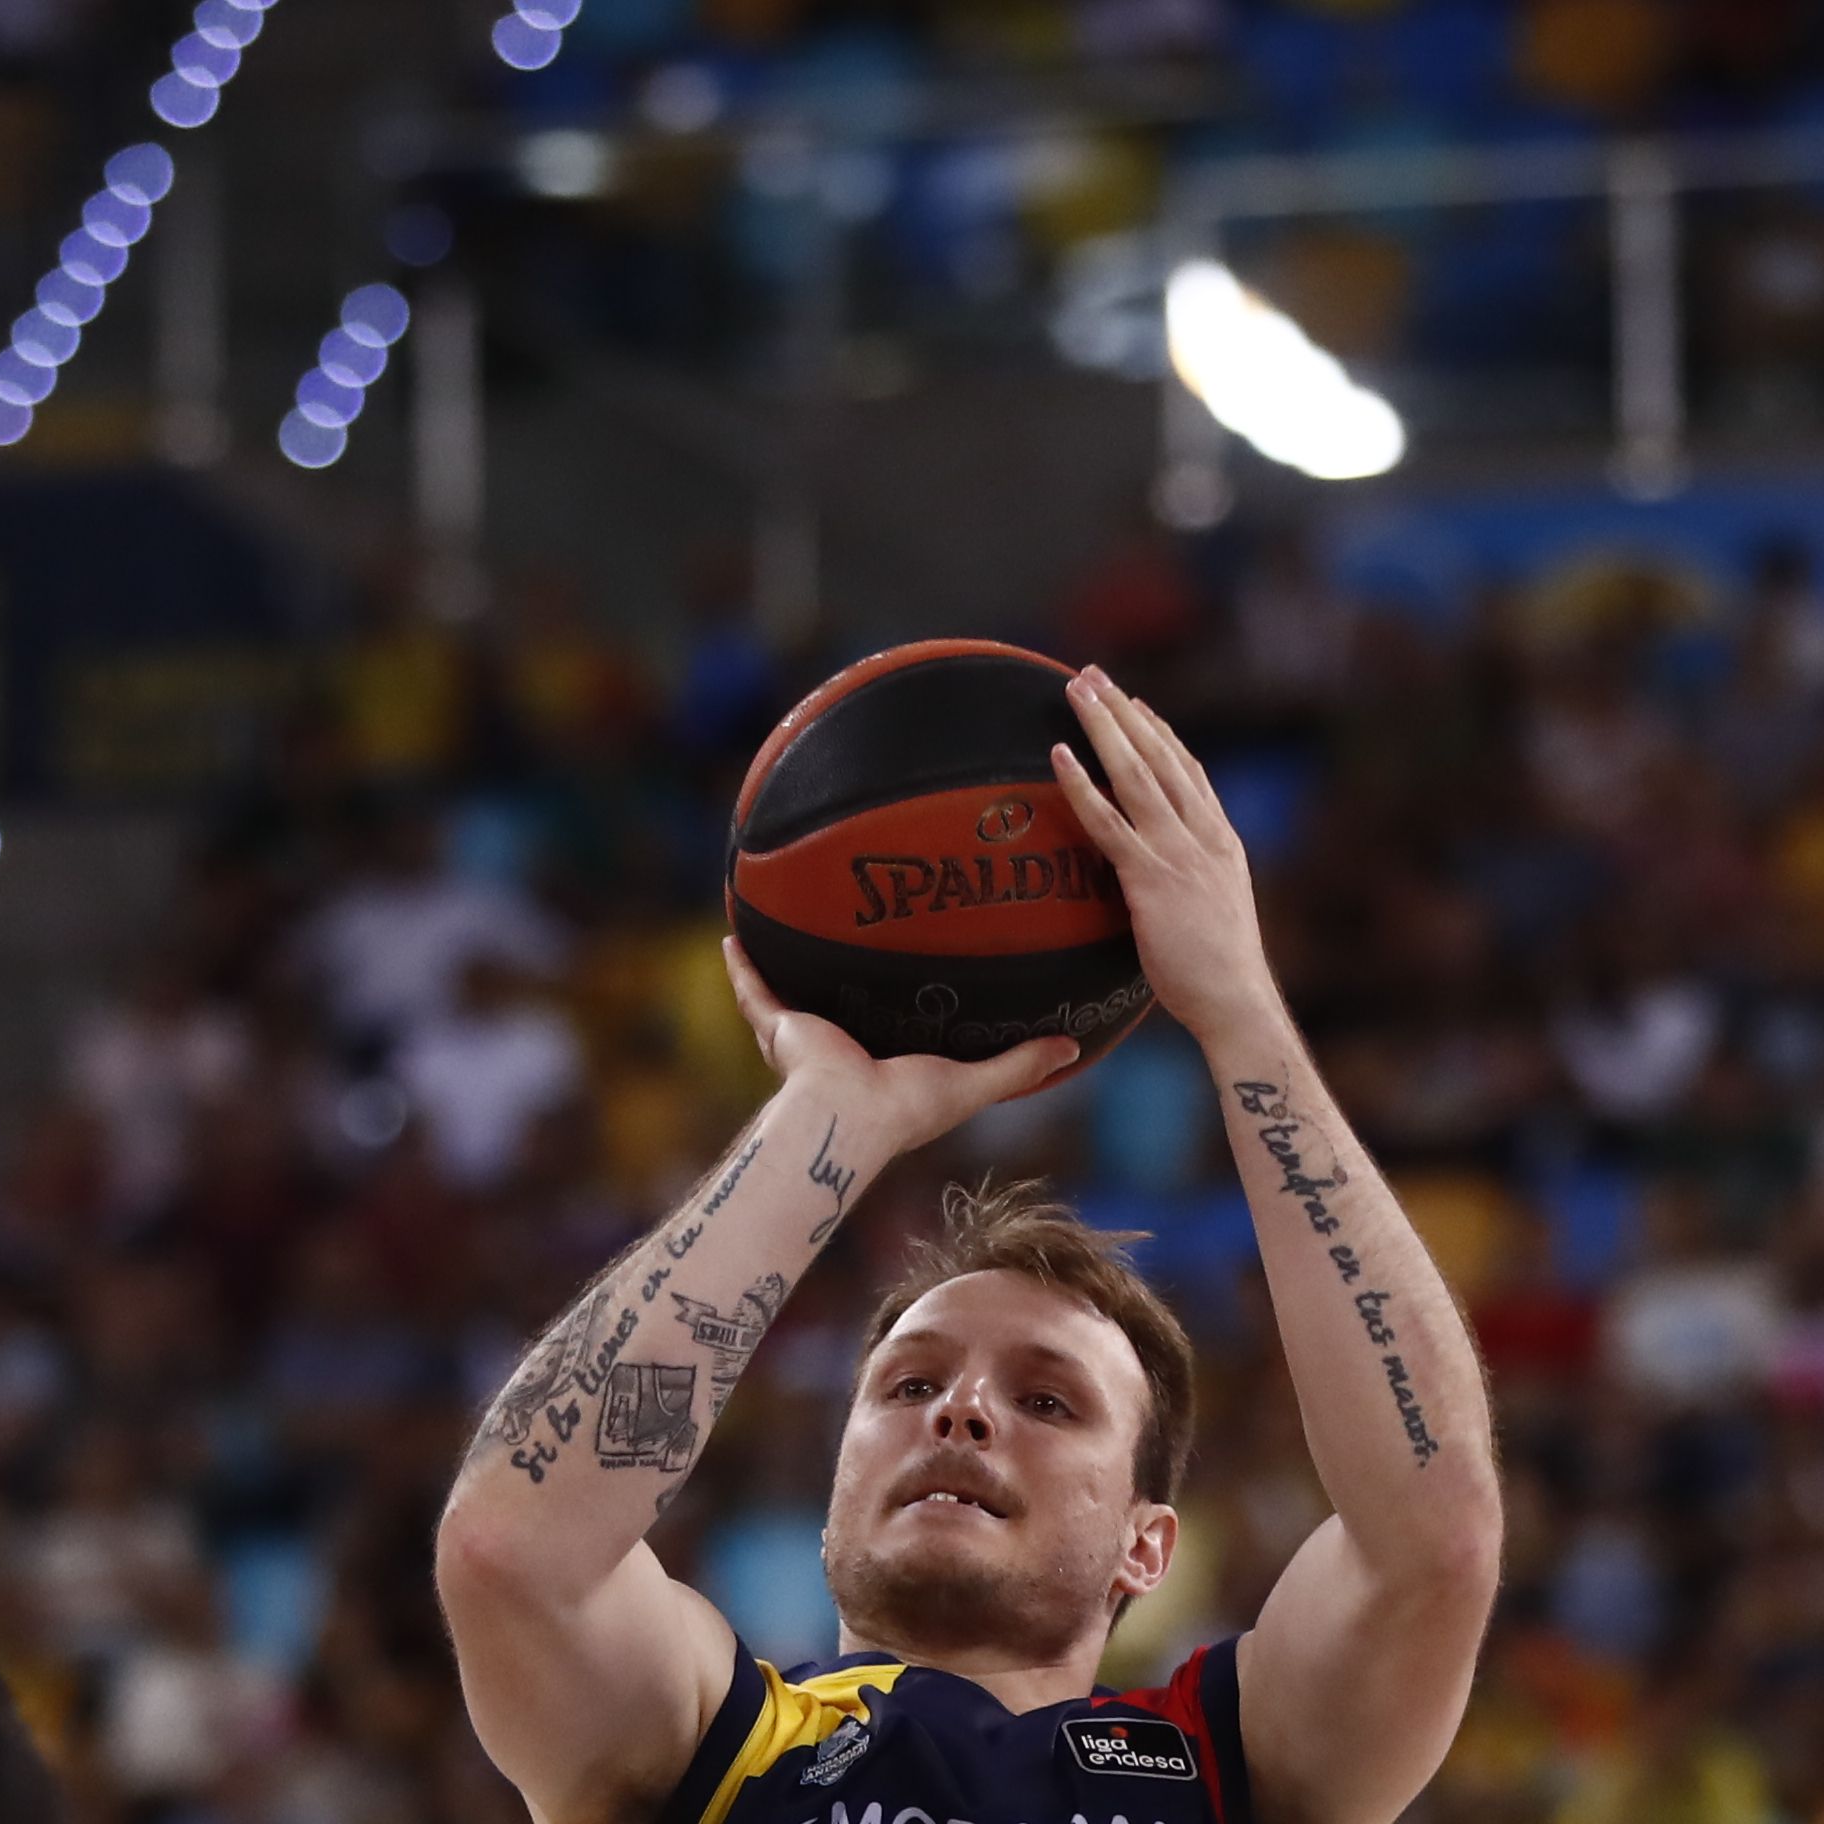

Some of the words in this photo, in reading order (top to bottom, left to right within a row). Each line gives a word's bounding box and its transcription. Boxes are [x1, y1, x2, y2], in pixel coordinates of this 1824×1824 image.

[851, 846, 1120, 928] SPALDIN
[1080, 1734, 1128, 1753] liga
[1089, 1751, 1186, 1771] endesa
